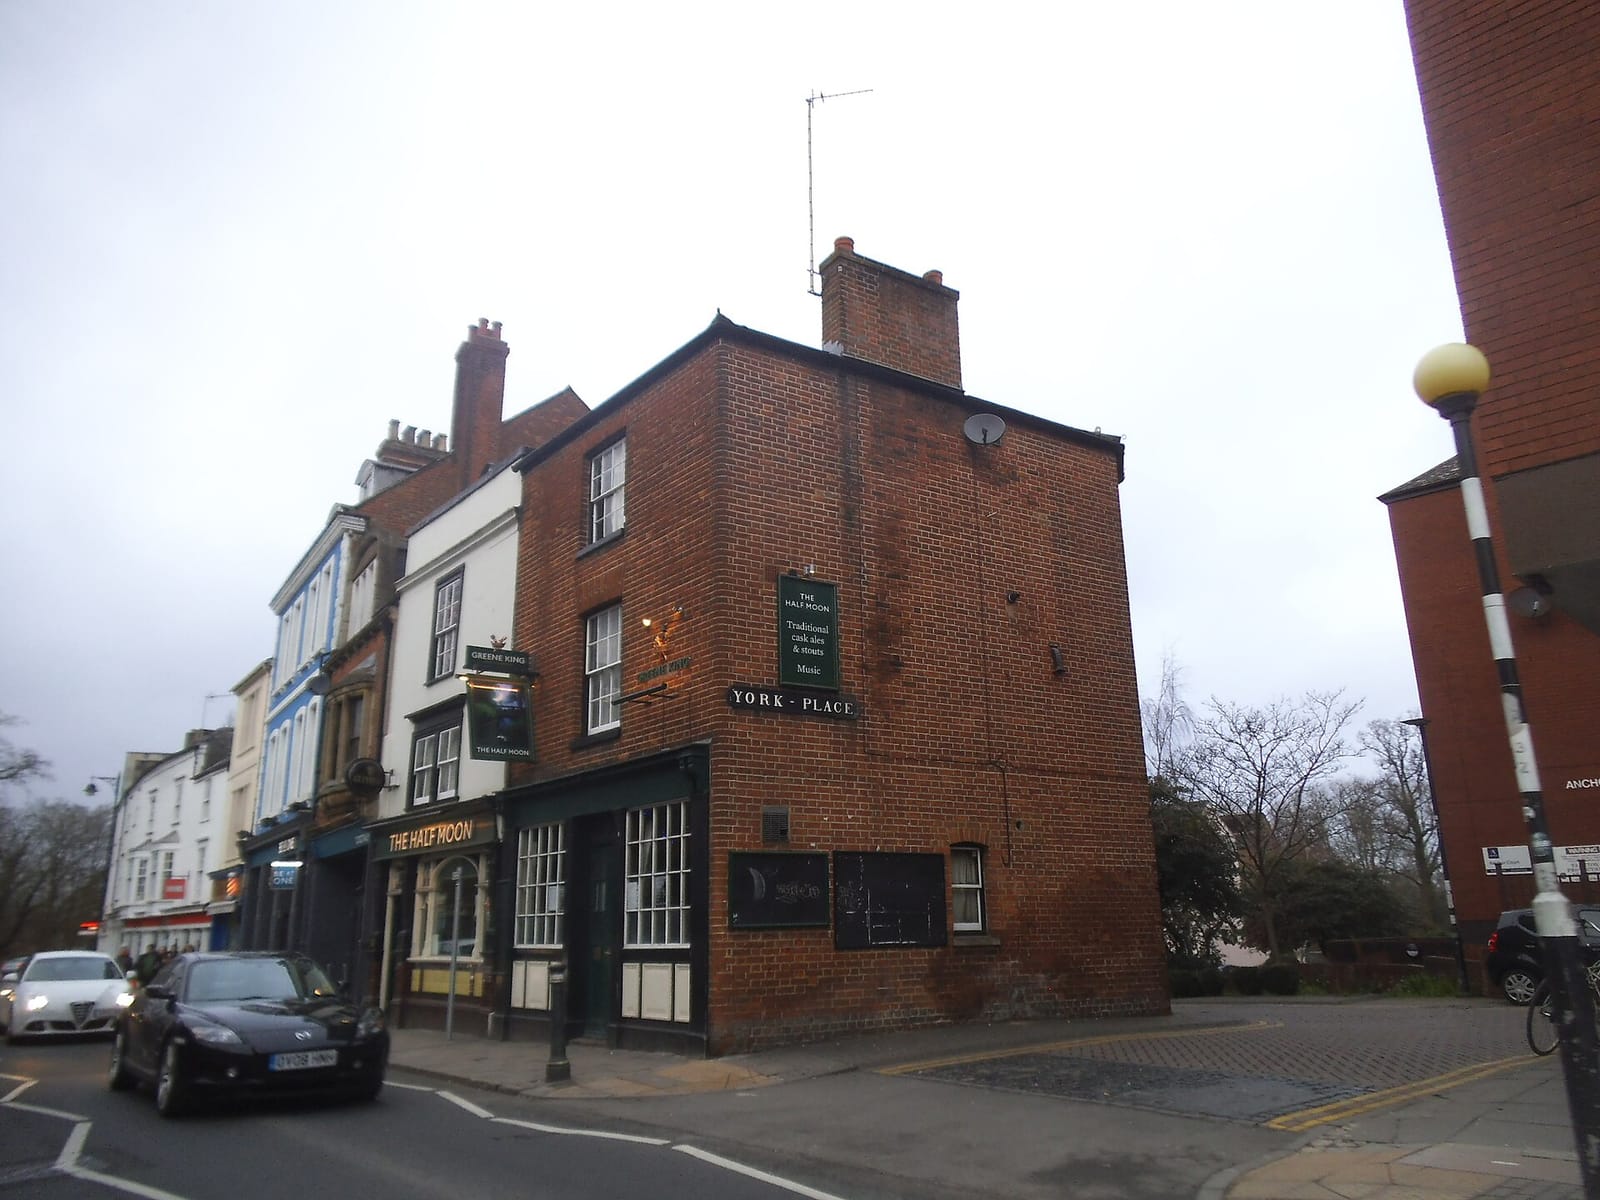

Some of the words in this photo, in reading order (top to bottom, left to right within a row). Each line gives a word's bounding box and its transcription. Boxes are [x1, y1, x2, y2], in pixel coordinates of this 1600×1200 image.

[800, 593, 815, 602] THE
[785, 600, 804, 609] HALF
[806, 603, 830, 612] MOON
[786, 620, 829, 634] Traditional
[791, 634, 809, 643] cask
[809, 636, 825, 645] ales
[792, 645, 800, 653] &
[801, 646, 824, 656] stouts
[471, 651, 503, 662] GREENE
[504, 655, 526, 664] KING
[797, 664, 821, 675] Music
[731, 688, 783, 707] YORK
[802, 697, 854, 715] PLACE
[476, 746, 490, 754] THE
[389, 832, 408, 852] THE
[409, 828, 436, 849] HALF
[437, 820, 473, 845] MOON
[273, 877, 294, 885] ONE
